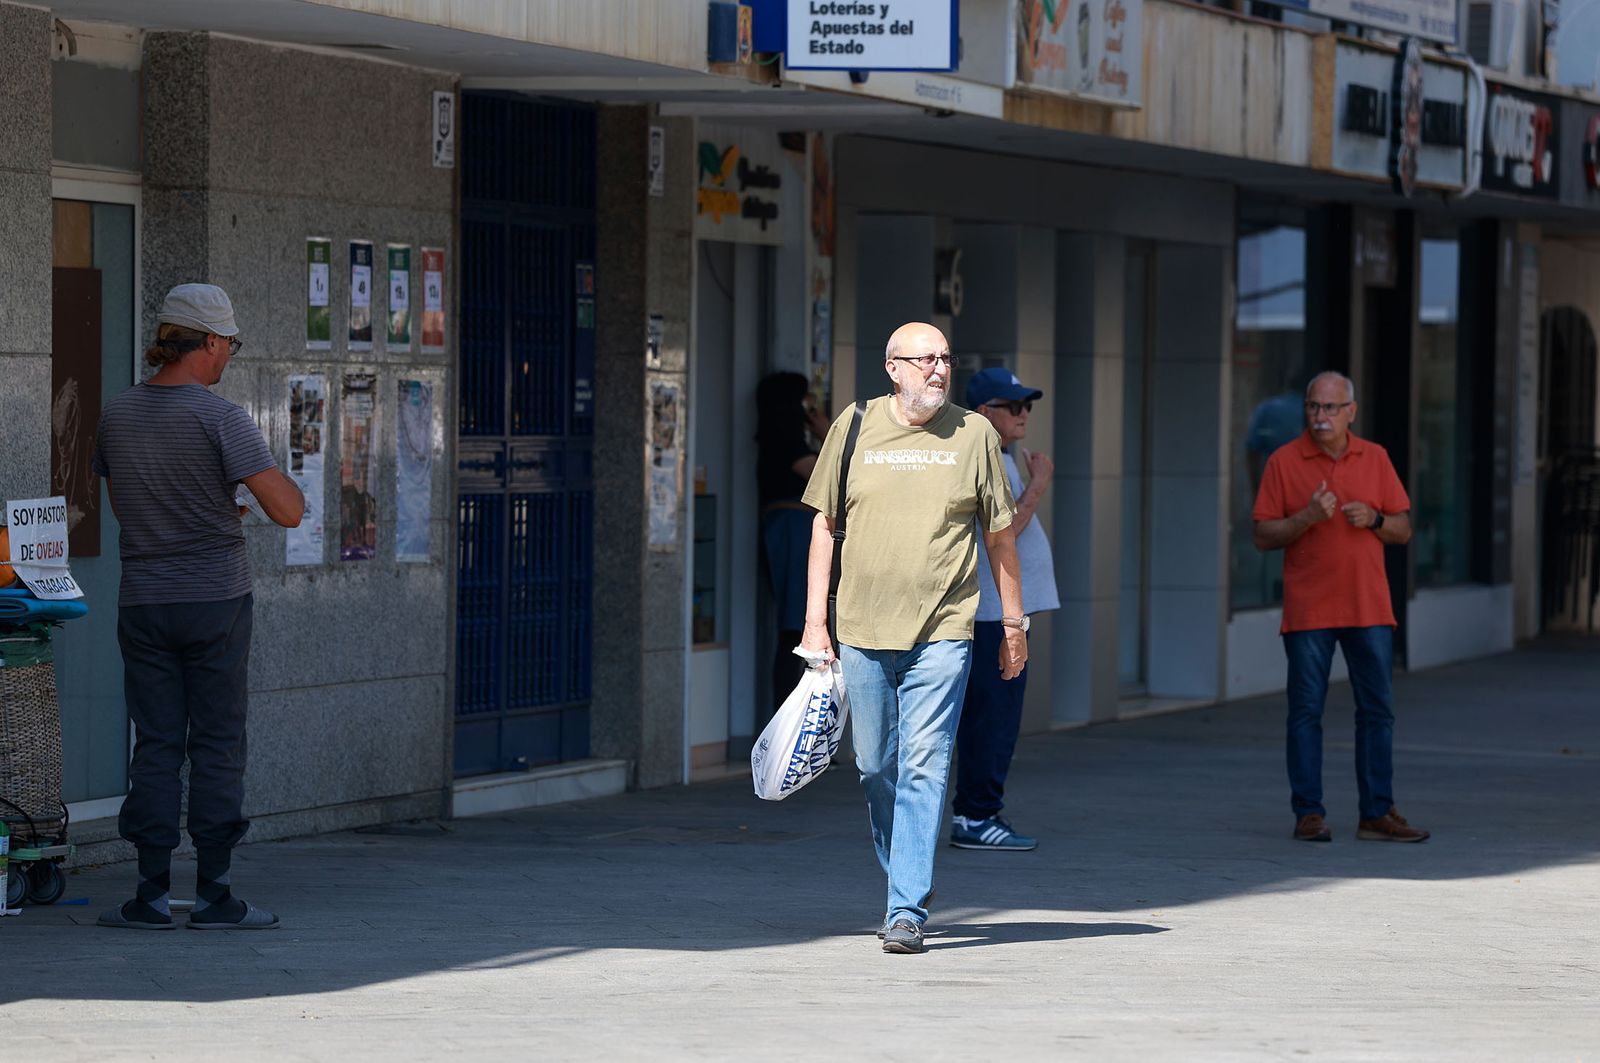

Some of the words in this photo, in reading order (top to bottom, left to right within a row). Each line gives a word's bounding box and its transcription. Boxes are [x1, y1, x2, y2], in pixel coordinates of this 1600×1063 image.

[809, 1, 875, 16] Loterías
[880, 4, 889, 19] y
[810, 21, 884, 38] Apuestas
[889, 20, 914, 35] del
[809, 40, 865, 55] Estado
[863, 449, 958, 465] INNSBRUCK
[13, 508, 35, 526] SOY
[37, 505, 66, 525] PASTOR
[21, 544, 34, 561] DE
[36, 541, 64, 560] OVEJAS
[35, 576, 76, 594] TRABAJO
